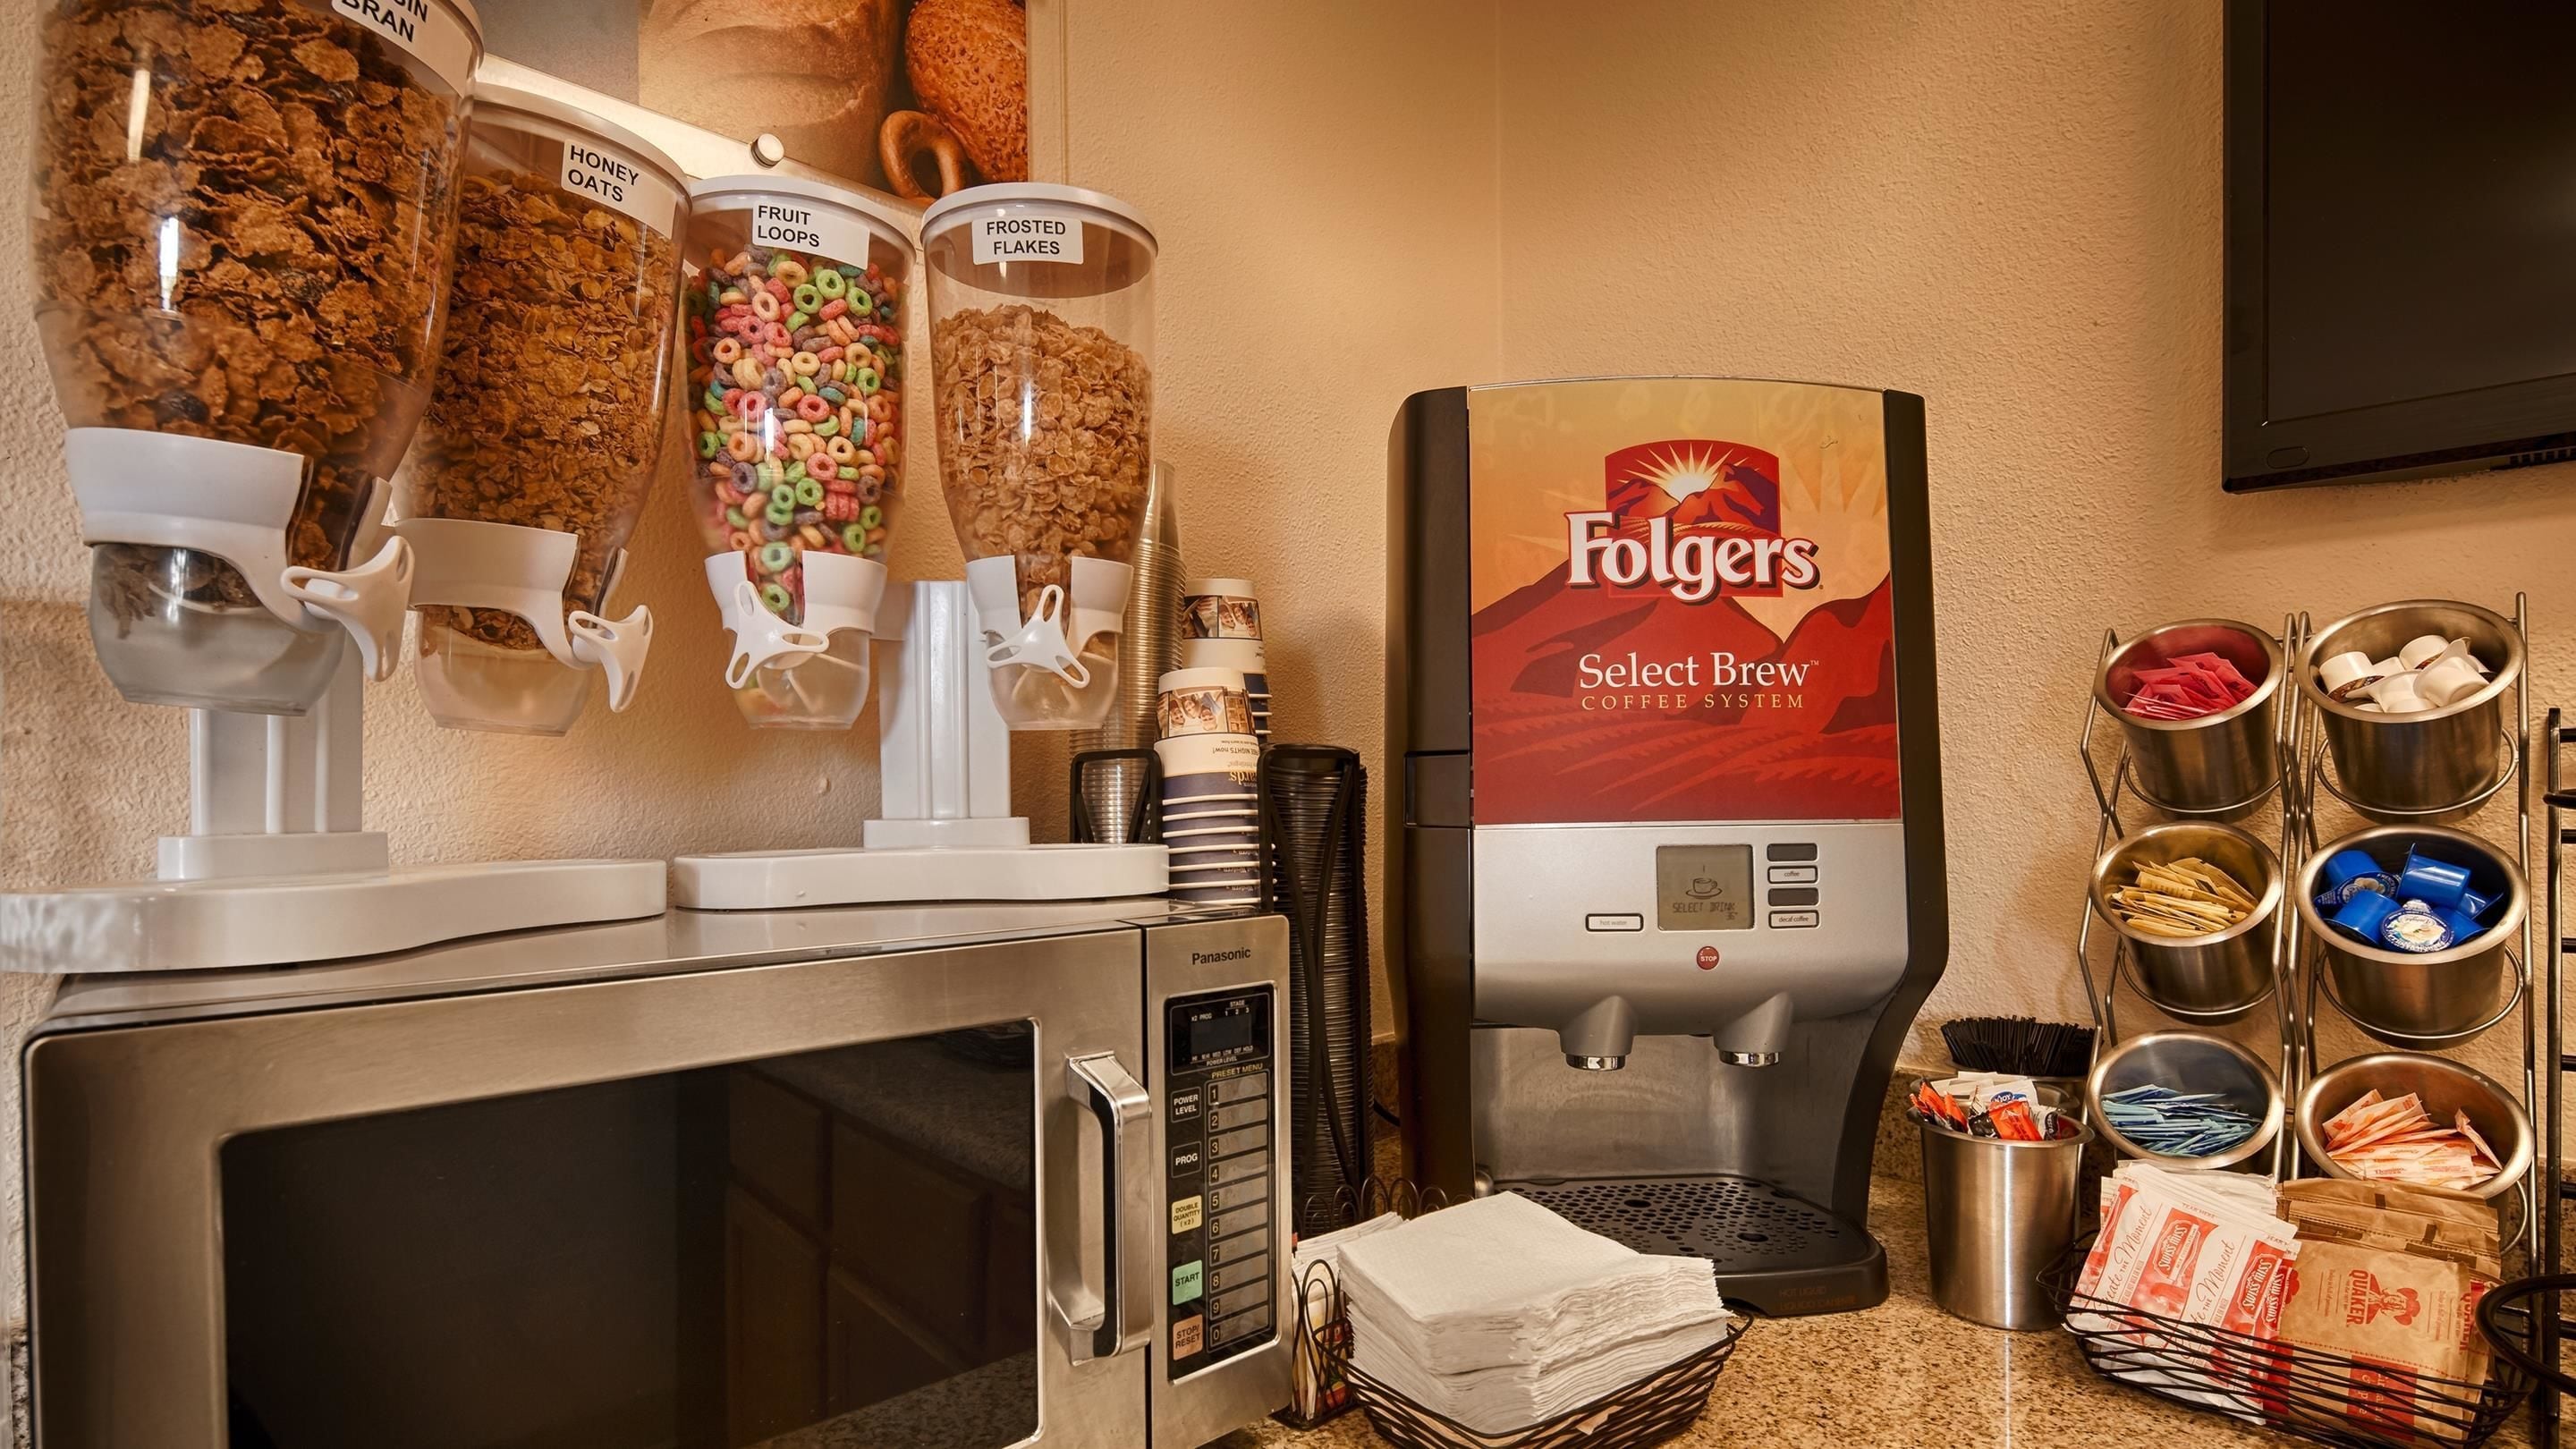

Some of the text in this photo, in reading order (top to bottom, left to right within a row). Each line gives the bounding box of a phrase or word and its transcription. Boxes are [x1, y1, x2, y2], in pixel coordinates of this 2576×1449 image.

[570, 145, 640, 186] HONEY
[568, 168, 623, 203] OATS
[758, 205, 811, 225] FRUIT
[987, 219, 1066, 235] FROSTED
[758, 225, 819, 248] LOOPS
[994, 240, 1061, 255] FLAKES
[1565, 511, 1820, 606] Folgers
[1579, 651, 1810, 689] Select Brew
[1581, 693, 1803, 710] COFFEE SYSTEM
[1672, 901, 1735, 913] SELECT DRINK
[1191, 946, 1251, 965] Panasonic
[1223, 1055, 1238, 1063] LEVEL
[1211, 1063, 1264, 1080] PRESET MENU
[1174, 1094, 1199, 1106] POWER
[1211, 1089, 1217, 1100] 1
[1175, 1105, 1197, 1115] LEVEL
[1211, 1114, 1218, 1127] 2
[1211, 1141, 1218, 1153] 3
[1174, 1152, 1199, 1166] PROG
[1211, 1168, 1218, 1180] 4
[1174, 1202, 1199, 1214] DOUBLE
[1212, 1195, 1218, 1208] 5
[1173, 1209, 1200, 1222] QUANTITY
[1212, 1222, 1219, 1233] 6
[2114, 1206, 2152, 1266] Moment
[1212, 1249, 1219, 1261] 7
[2120, 1260, 2129, 1275] THE
[2196, 1239, 2235, 1311] THE Moment
[1174, 1272, 1199, 1288] START
[1212, 1275, 1220, 1287] 8
[2347, 1269, 2368, 1326] QUAKER
[1212, 1301, 1220, 1314] 9
[1176, 1324, 1199, 1340] STOP/
[1213, 1328, 1220, 1341] 0
[1175, 1333, 1200, 1349] RESET
